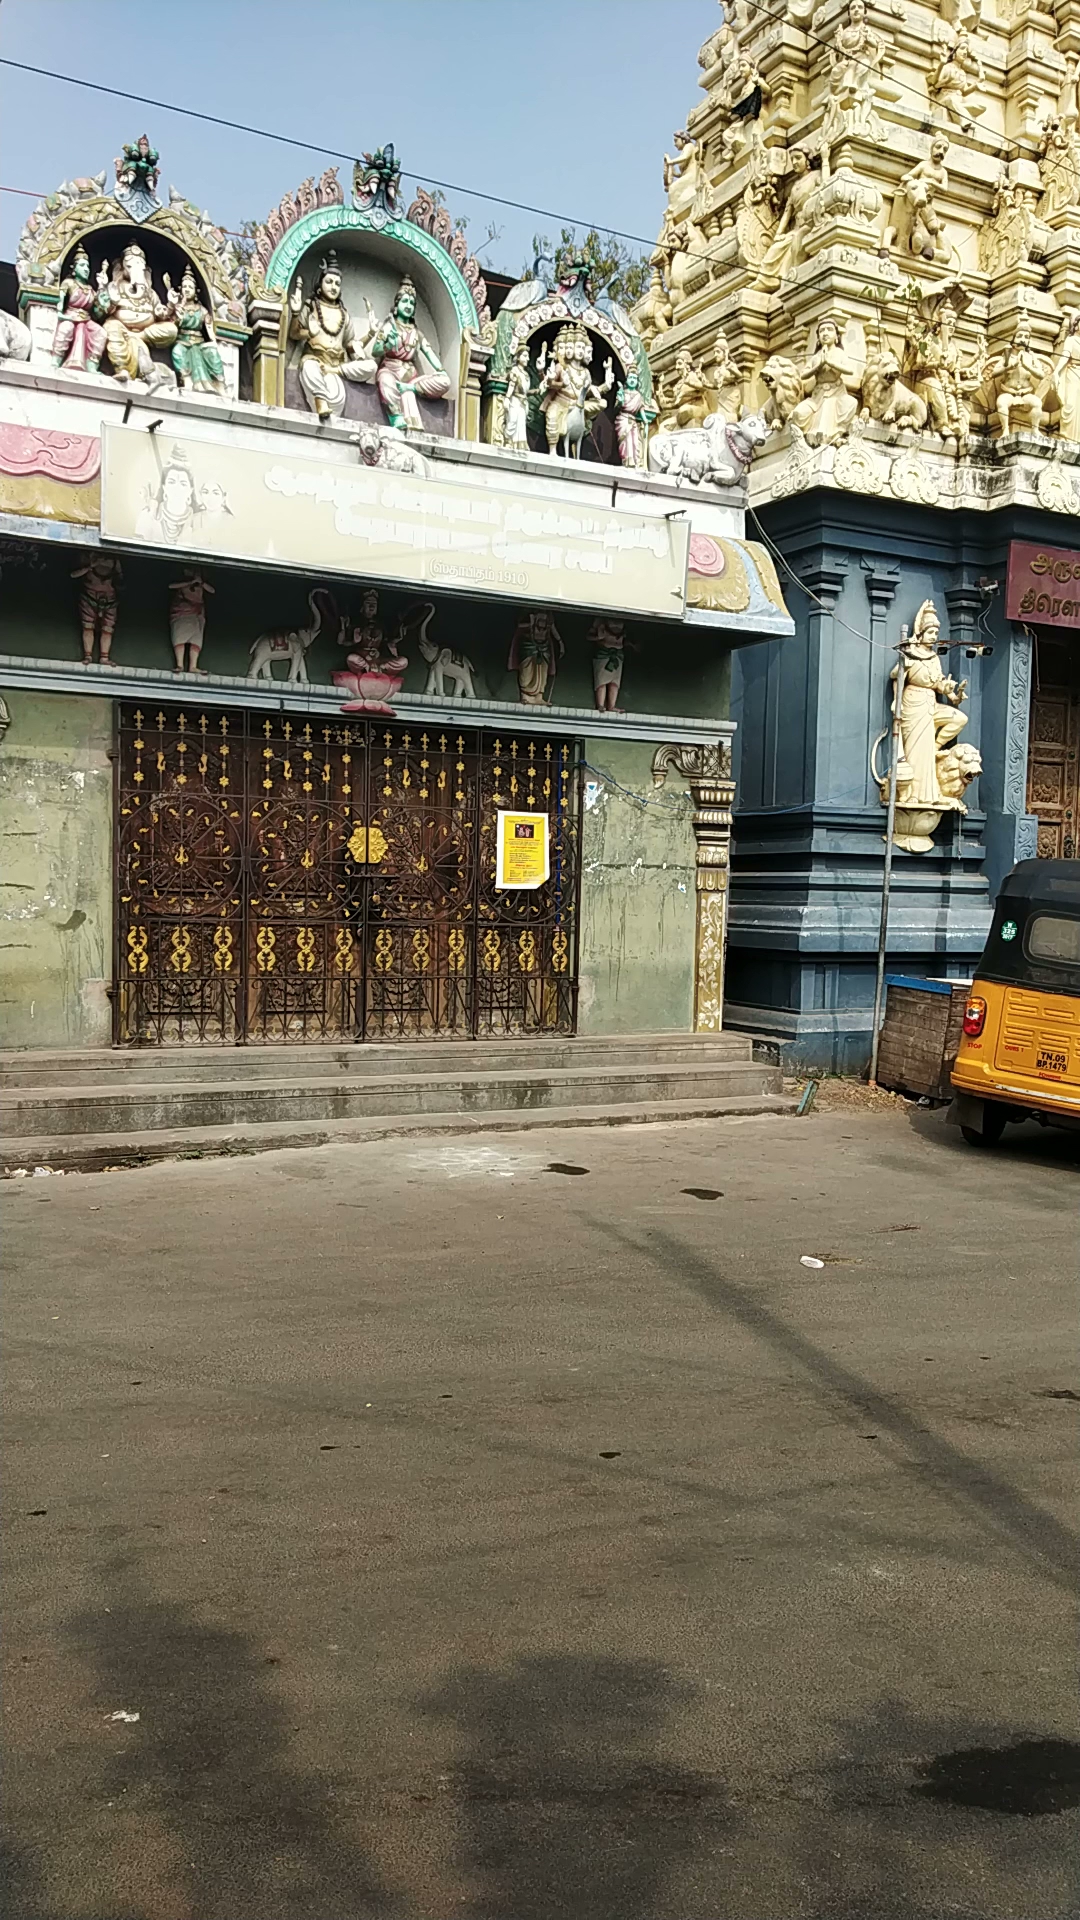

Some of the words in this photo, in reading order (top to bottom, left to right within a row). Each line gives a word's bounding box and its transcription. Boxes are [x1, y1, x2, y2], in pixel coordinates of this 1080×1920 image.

[497, 570, 529, 590] 1910)
[1041, 1051, 1066, 1063] TN.09
[1036, 1059, 1067, 1072] BP.1479
